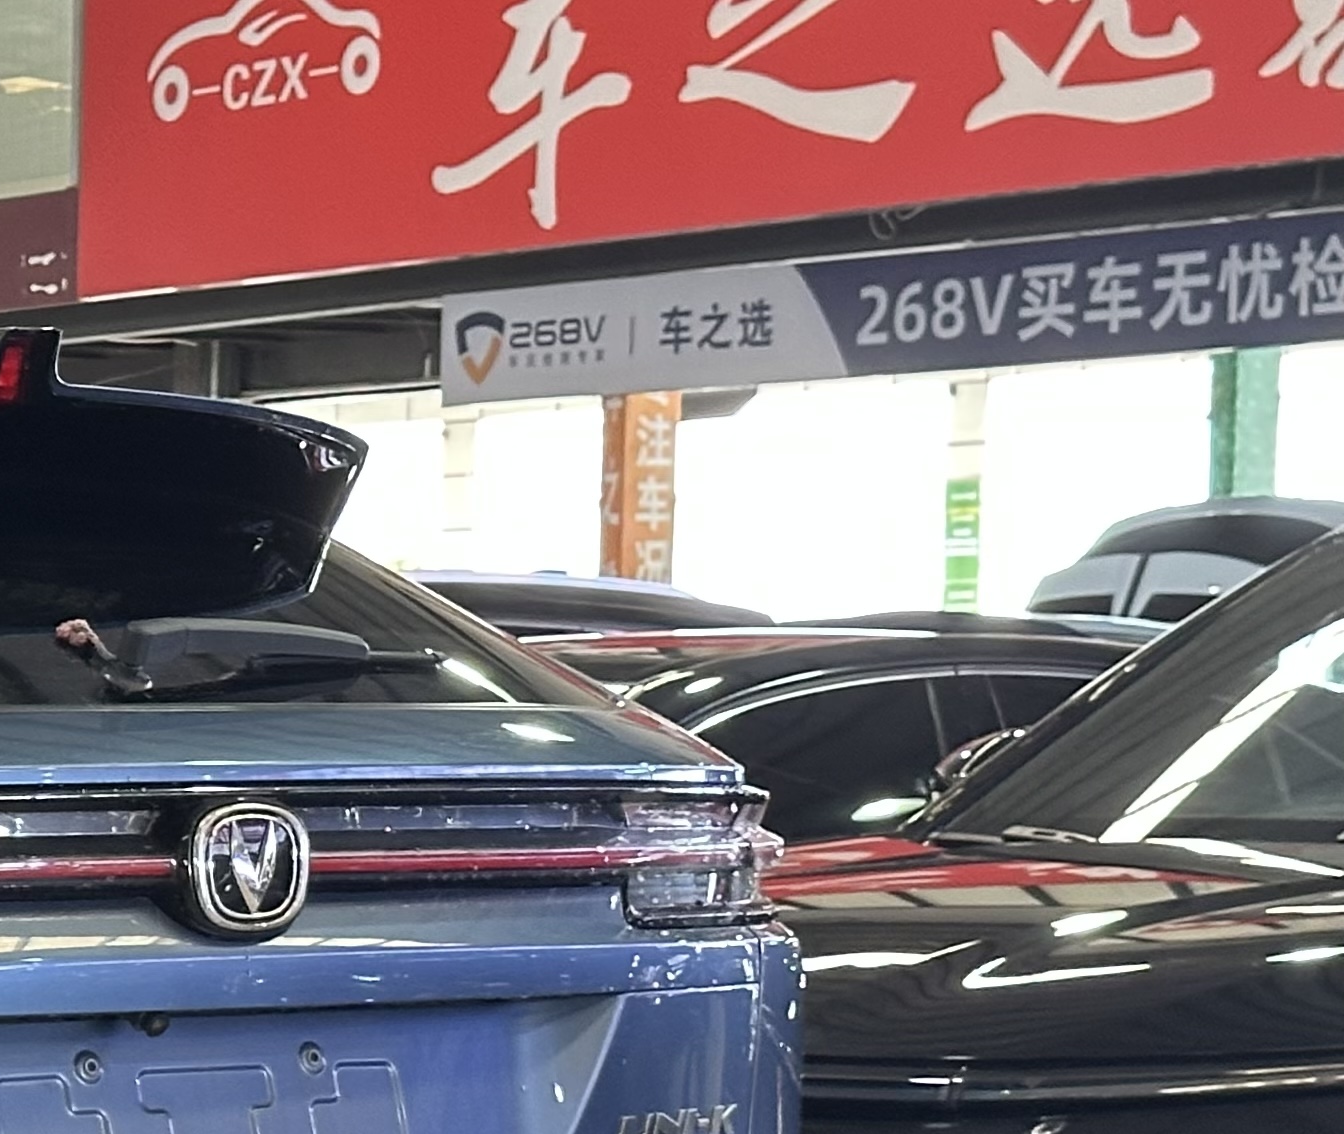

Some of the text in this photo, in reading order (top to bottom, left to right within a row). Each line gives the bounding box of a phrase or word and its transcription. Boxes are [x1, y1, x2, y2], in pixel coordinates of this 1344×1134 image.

[222, 52, 310, 112] CZX
[431, 0, 1344, 230] 车之选
[509, 314, 606, 349] 268V
[659, 299, 773, 354] 车之选
[634, 392, 673, 584] 注车况
